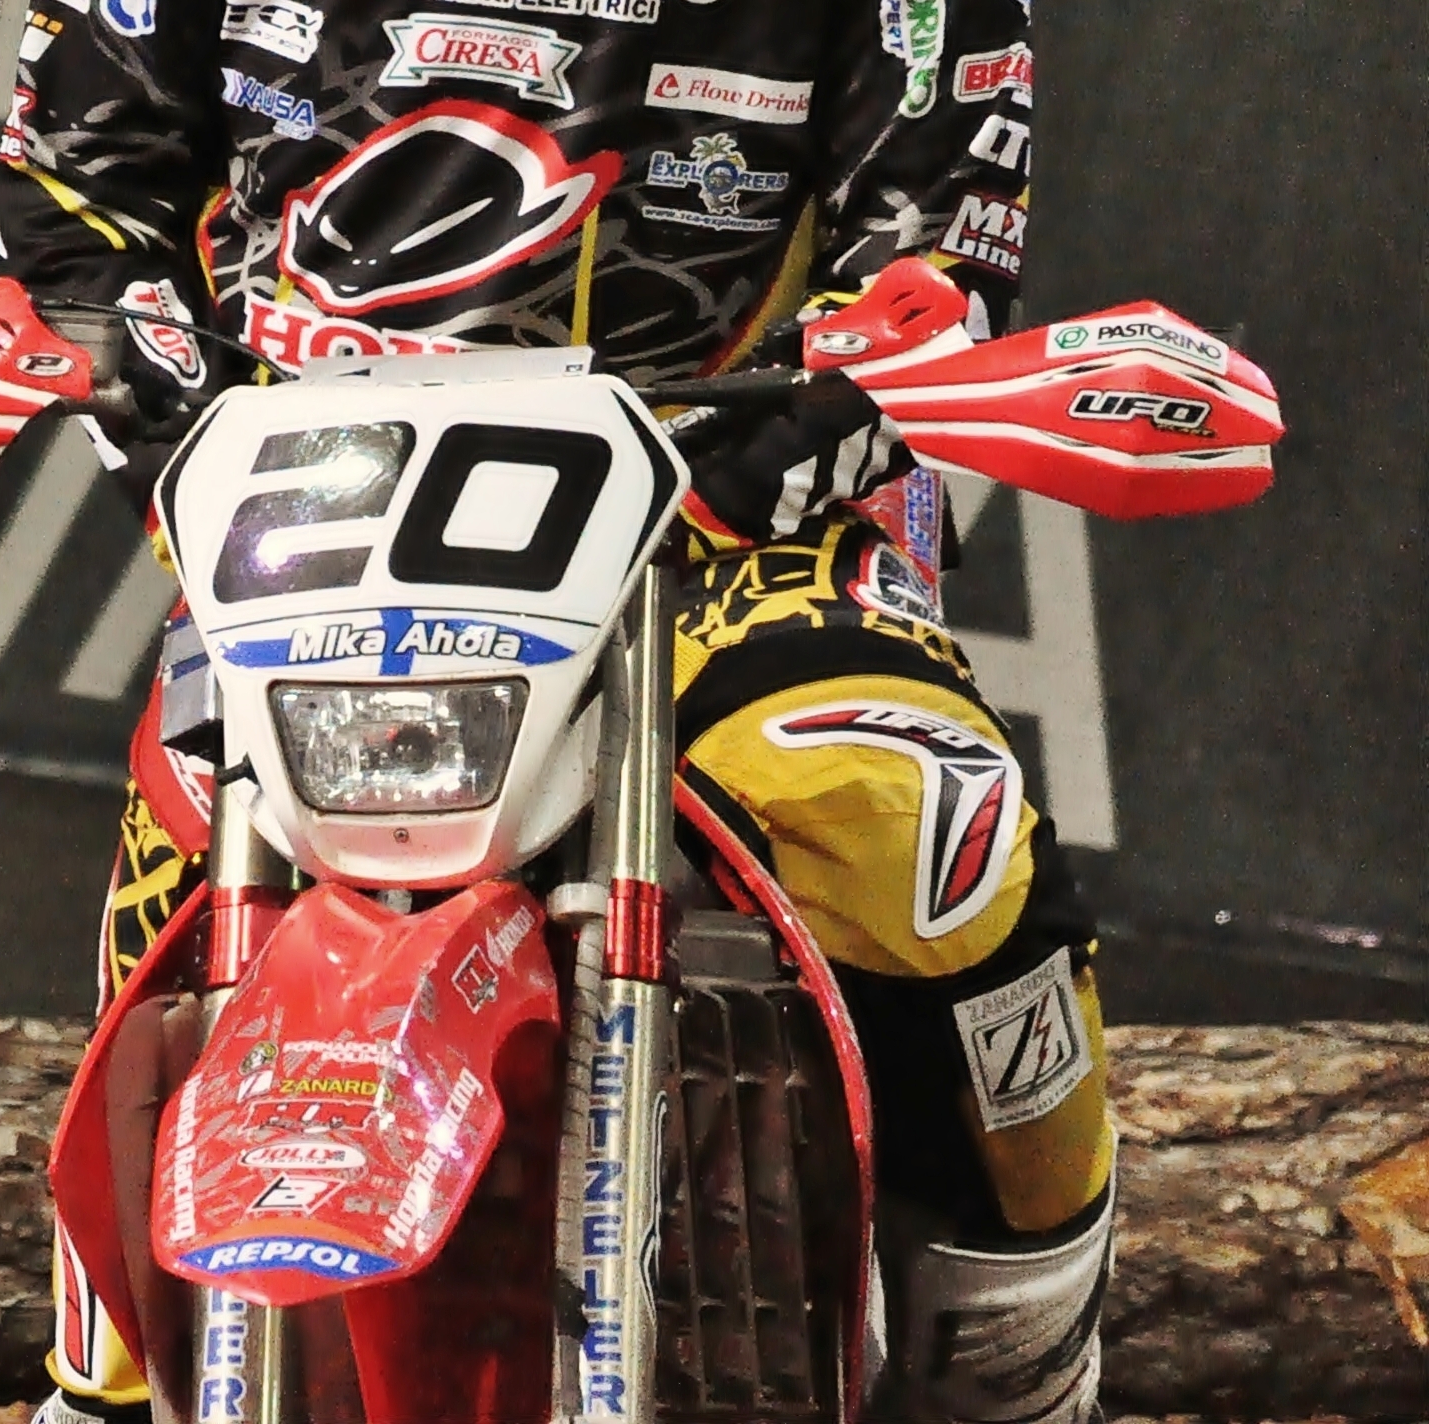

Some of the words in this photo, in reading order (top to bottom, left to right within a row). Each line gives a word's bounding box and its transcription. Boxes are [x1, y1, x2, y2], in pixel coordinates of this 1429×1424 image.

[415, 27, 543, 78] CIRESA
[687, 79, 741, 103] Flow
[1096, 324, 1223, 362] PASTORINO
[1070, 393, 1209, 429] UFO
[212, 420, 614, 604] 20
[287, 623, 386, 662] Mika
[396, 622, 522, 660] Ahola
[852, 708, 979, 750] UFO
[583, 1004, 636, 1416] METZELER
[208, 1239, 360, 1274] REPSOL
